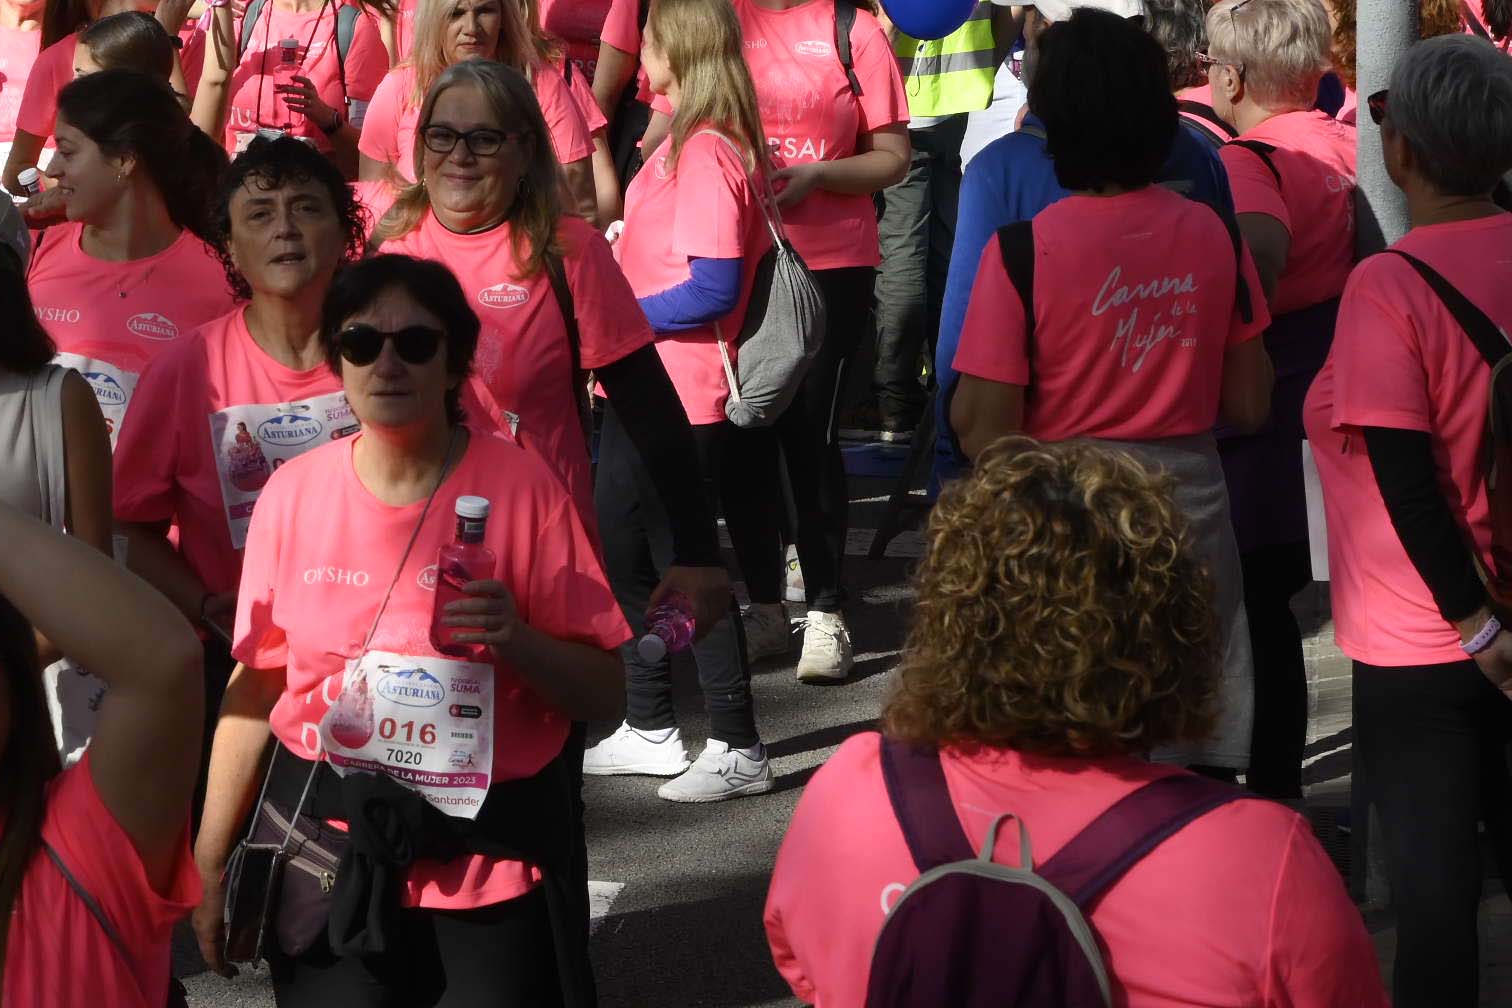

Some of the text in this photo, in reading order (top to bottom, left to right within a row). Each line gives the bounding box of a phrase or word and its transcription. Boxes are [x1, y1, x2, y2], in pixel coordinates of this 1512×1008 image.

[744, 38, 768, 49] SHO
[33, 306, 81, 324] YSHO
[1110, 307, 1182, 374] Mujer
[263, 425, 319, 440] ASTURIANA
[303, 567, 370, 586] OYSHO
[382, 684, 440, 700] ASTURIANA
[450, 684, 481, 695] SUMA
[378, 717, 438, 745] 016
[386, 748, 423, 766] 7020
[401, 772, 413, 781] LA
[415, 774, 450, 785] MUJER
[453, 776, 477, 785] 2023
